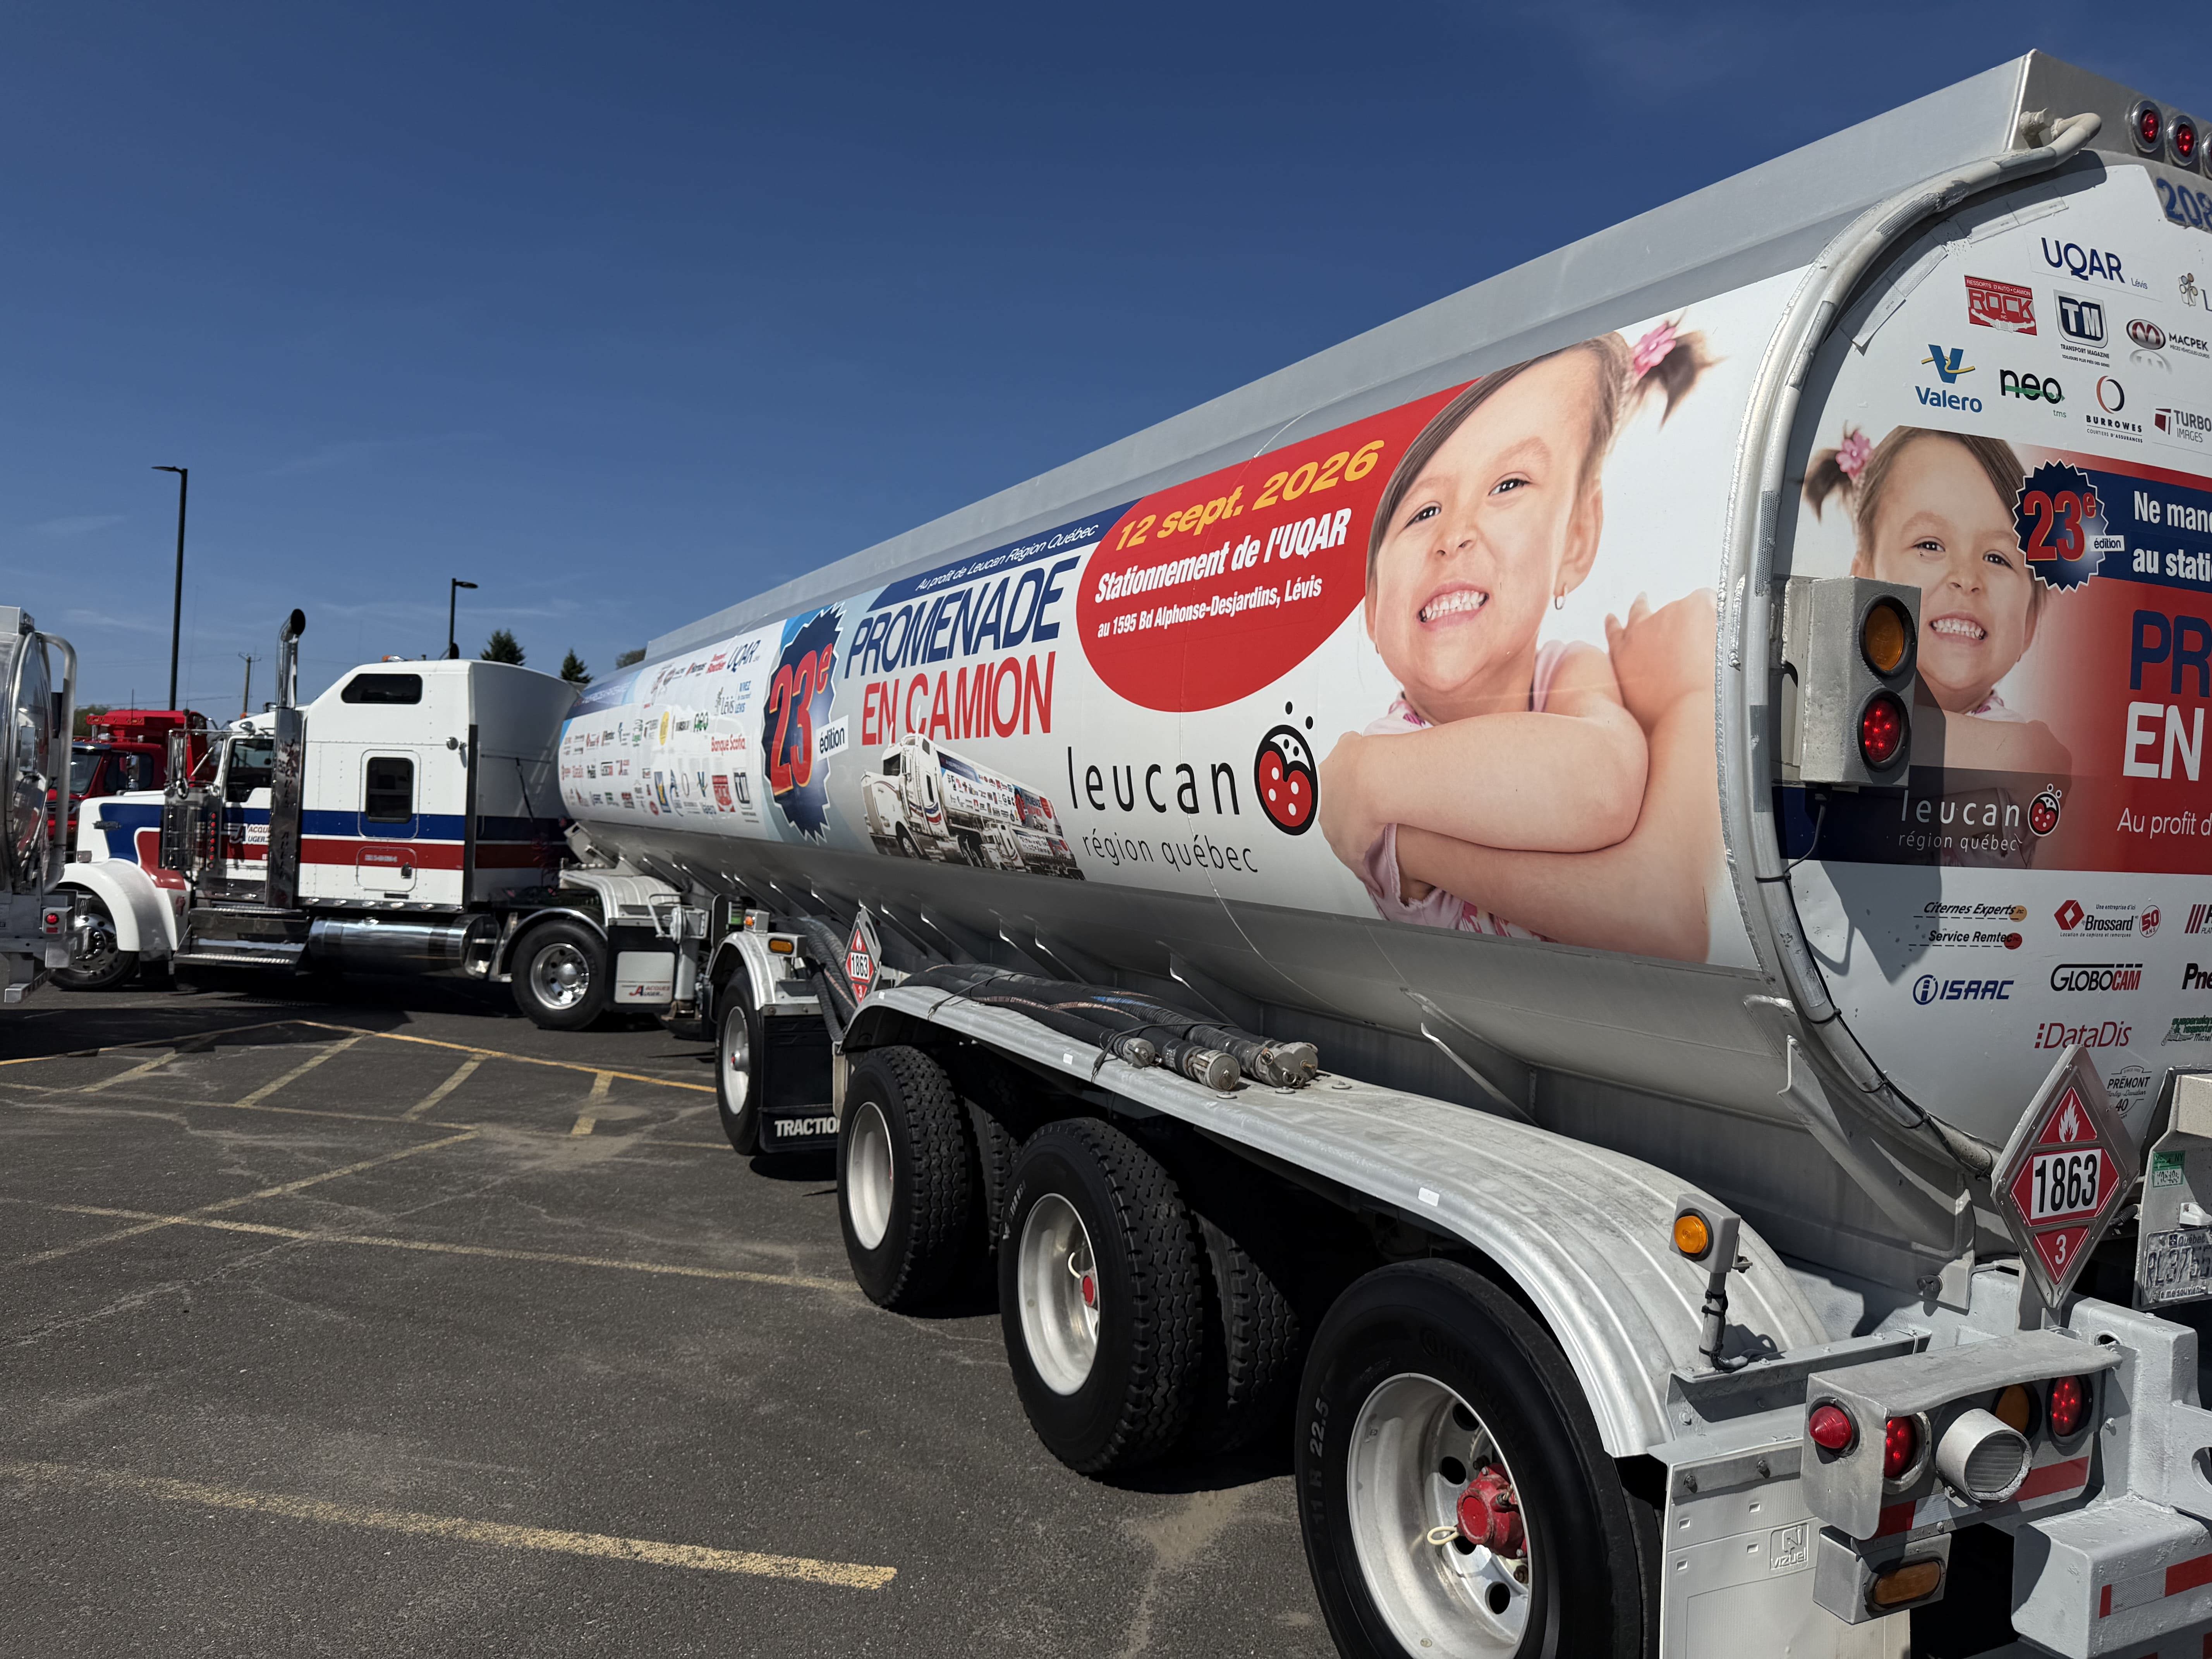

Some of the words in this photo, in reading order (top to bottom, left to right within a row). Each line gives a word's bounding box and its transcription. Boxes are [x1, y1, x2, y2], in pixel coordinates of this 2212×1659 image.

[2041, 237, 2125, 284] UQAR
[2131, 278, 2148, 290] Lévis
[1967, 279, 1991, 288] RESSORTS
[1968, 289, 2035, 320] ROCK
[2062, 302, 2102, 338] TM
[2061, 343, 2086, 354] TRANSPORT
[2087, 349, 2110, 359] MAGAZINE
[2169, 332, 2209, 352] MACPEK
[1915, 386, 1982, 413] Valero
[1999, 369, 2062, 404] neo
[2053, 409, 2067, 418] tms
[2086, 415, 2142, 433] BURROWES
[2173, 410, 2212, 432] TURBO
[2087, 428, 2109, 437] COURTIERS
[2111, 433, 2143, 443] D'ASSURANCES
[2177, 428, 2203, 443] IMAGES
[1115, 514, 1157, 551] 12
[1158, 485, 1244, 539] sept.
[1252, 440, 1385, 511] 2026
[2134, 491, 2160, 524] Ne
[2167, 503, 2212, 534] man
[915, 578, 931, 591] Au
[927, 570, 956, 591] profit
[953, 567, 967, 579] de
[967, 554, 1007, 575] Leucan
[1006, 541, 1047, 563] Région
[1048, 524, 1099, 549] Québec
[1095, 540, 1231, 604] Stationnement
[1231, 535, 1259, 570] de
[1263, 508, 1352, 563] l'UQAR
[2094, 538, 2121, 550] édition
[2133, 548, 2159, 574] au
[2166, 549, 2212, 582] stati
[845, 555, 1081, 680] PROMENADE
[1097, 622, 1110, 638] au
[1113, 613, 1137, 635] 1595
[1139, 610, 1153, 631] Bd
[1154, 586, 1281, 629] Alphonse-Desjardins,
[1284, 575, 1322, 602] Lévis
[2130, 610, 2212, 697] PR
[861, 677, 900, 745] EN
[905, 651, 1056, 741] CAMION
[820, 726, 845, 754] édition
[2123, 701, 2204, 781] EN
[1068, 746, 1240, 816] leucan
[1901, 790, 2020, 827] leucan
[2117, 807, 2145, 832] Au
[2150, 811, 2197, 839] profit
[1082, 828, 1154, 866] région
[1162, 834, 1258, 876] québec
[1899, 831, 1952, 851] région
[1960, 833, 2017, 852] québec
[1924, 902, 1972, 914] Citernes
[1973, 903, 2016, 917] Experts
[2085, 915, 2134, 931] Brossard
[2142, 909, 2159, 932] 50
[1929, 930, 1970, 942] Service
[1972, 931, 2013, 942] Remtec
[2145, 927, 2156, 936] ANS
[852, 954, 868, 977] 1863
[858, 985, 863, 998] 3
[1939, 980, 2014, 1000] ISAAC
[2044, 1021, 2132, 1049] DataDis
[2116, 1098, 2129, 1111] 40
[2035, 1154, 2097, 1213] 1863
[2055, 1235, 2067, 1264] 3
[1309, 1396, 1329, 1458] 22.5
